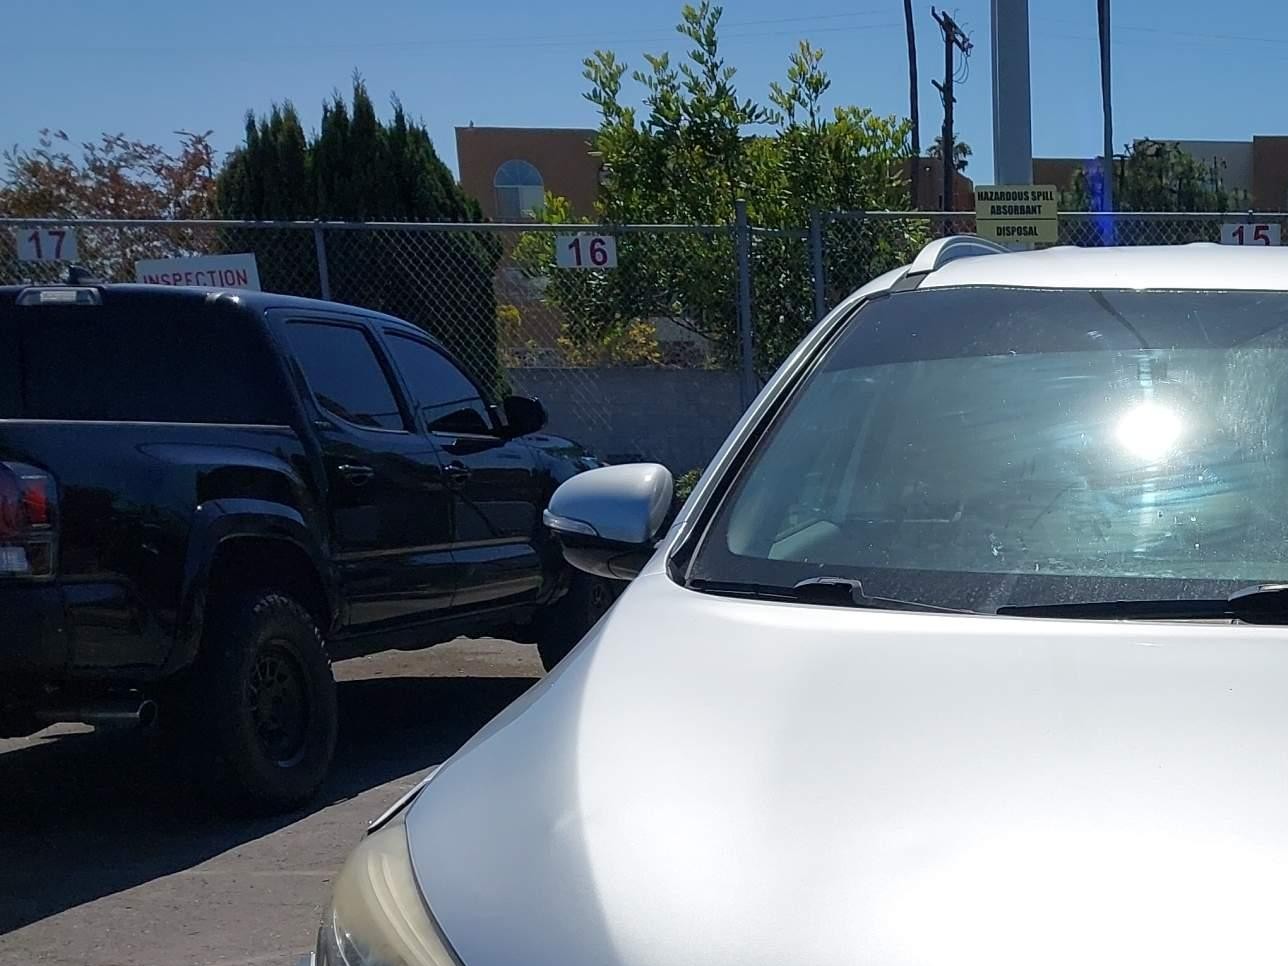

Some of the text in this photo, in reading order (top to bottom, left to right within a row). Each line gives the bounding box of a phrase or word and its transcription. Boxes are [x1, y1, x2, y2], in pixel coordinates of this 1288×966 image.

[977, 191, 1055, 201] HAZARDOUS SPILL
[990, 204, 1042, 215] ABSORBANT
[996, 226, 1039, 237] DISPOSAL
[1232, 225, 1270, 246] 15
[28, 231, 66, 259] 17
[568, 237, 608, 266] 16
[143, 268, 249, 287] INSPECTION
